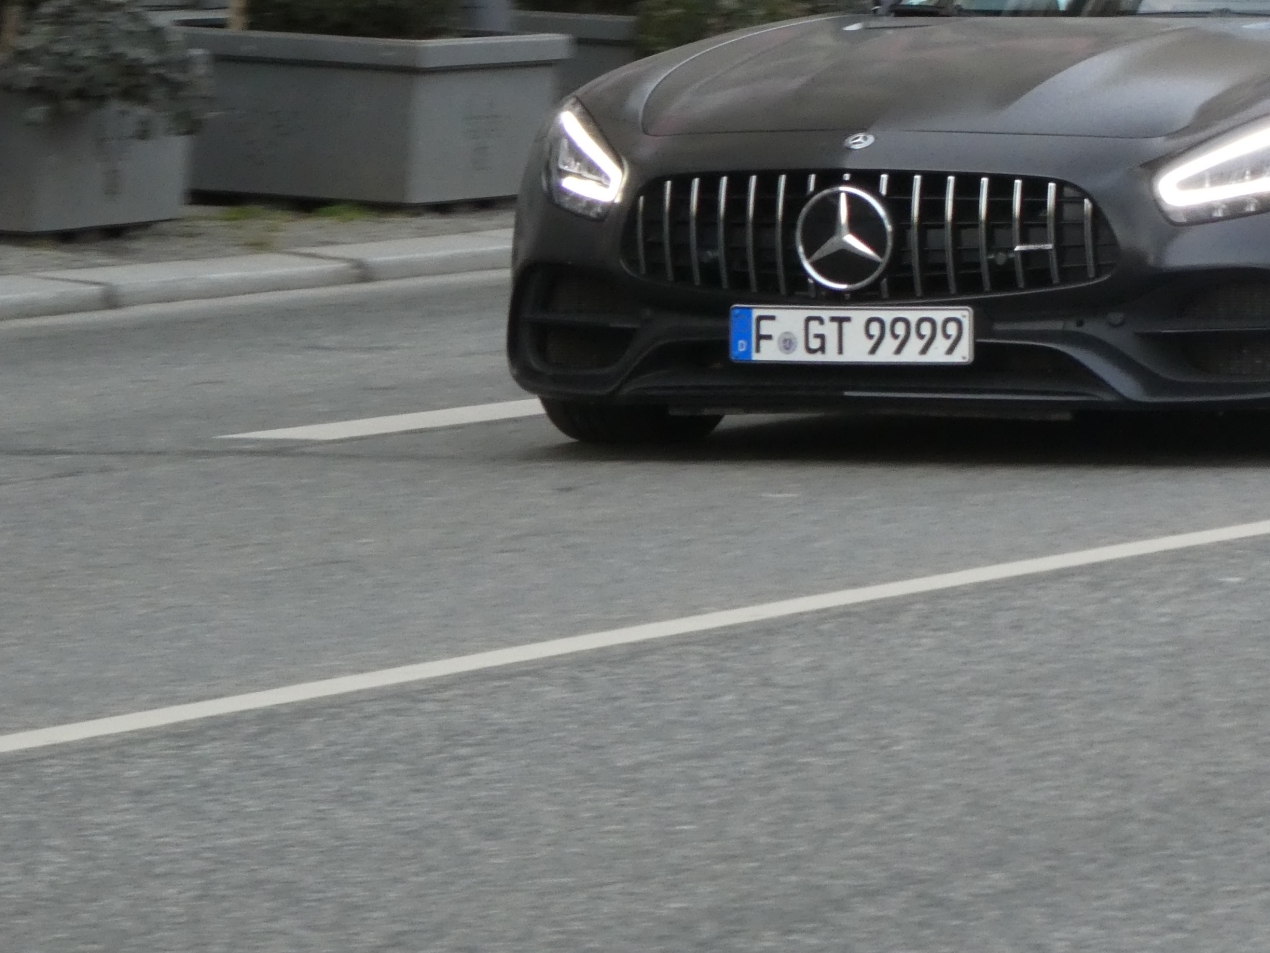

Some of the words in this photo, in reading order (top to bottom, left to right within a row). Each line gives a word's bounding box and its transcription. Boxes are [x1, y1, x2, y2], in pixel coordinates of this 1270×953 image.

[754, 314, 776, 354] F
[803, 315, 852, 355] GT
[864, 316, 964, 356] 9999
